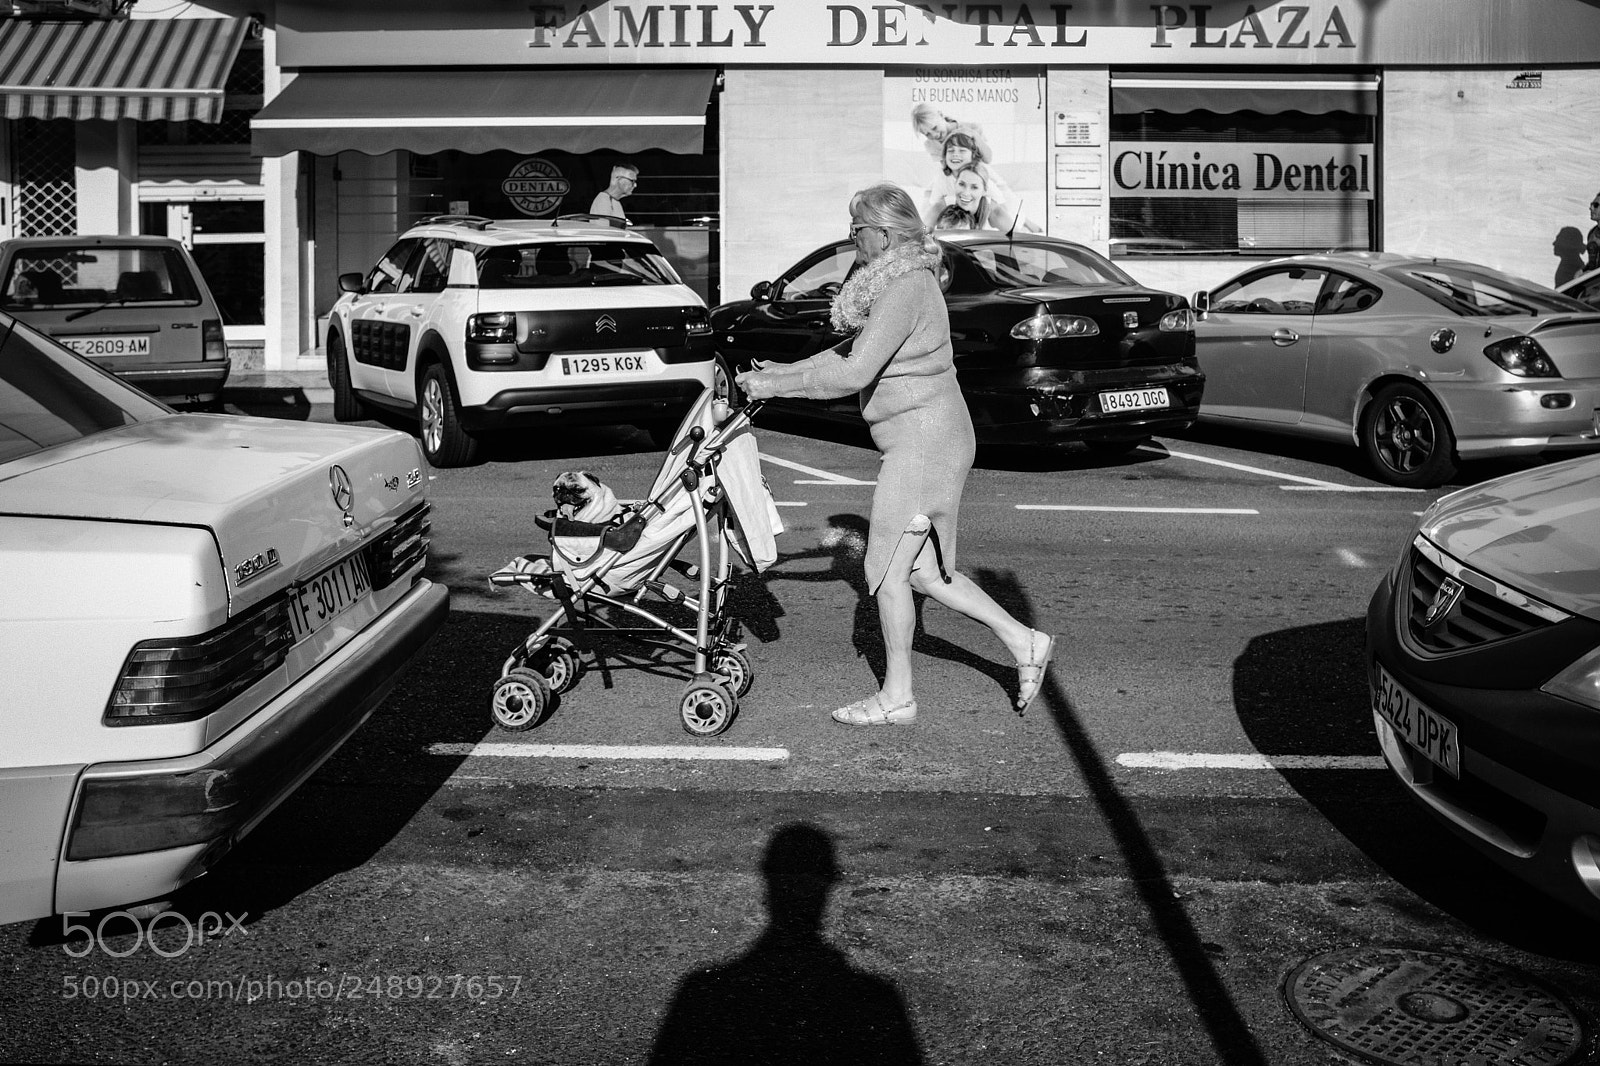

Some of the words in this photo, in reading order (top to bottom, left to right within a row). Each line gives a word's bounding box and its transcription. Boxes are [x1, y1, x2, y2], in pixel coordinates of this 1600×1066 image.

[528, 4, 775, 48] FAMILY
[1150, 4, 1357, 49] PLAZA
[915, 68, 930, 83] SU
[933, 68, 984, 83] SONRISA
[912, 88, 927, 102] EN
[929, 88, 975, 102] BUENAS
[977, 88, 1019, 103] MANOS
[517, 163, 554, 176] FAMILY
[1113, 150, 1242, 191] Clínica
[1252, 153, 1371, 192] Dental
[508, 181, 564, 192] DENTAL
[519, 199, 554, 211] PLAZA
[573, 358, 610, 374] 1295
[614, 356, 644, 371] KGX
[1109, 392, 1142, 409] 8492
[1144, 390, 1167, 407] DGC
[289, 587, 310, 635] TF
[312, 564, 352, 620] 3011
[349, 551, 371, 596] AN
[1381, 673, 1412, 737] 5424
[1417, 706, 1451, 769] DPK
